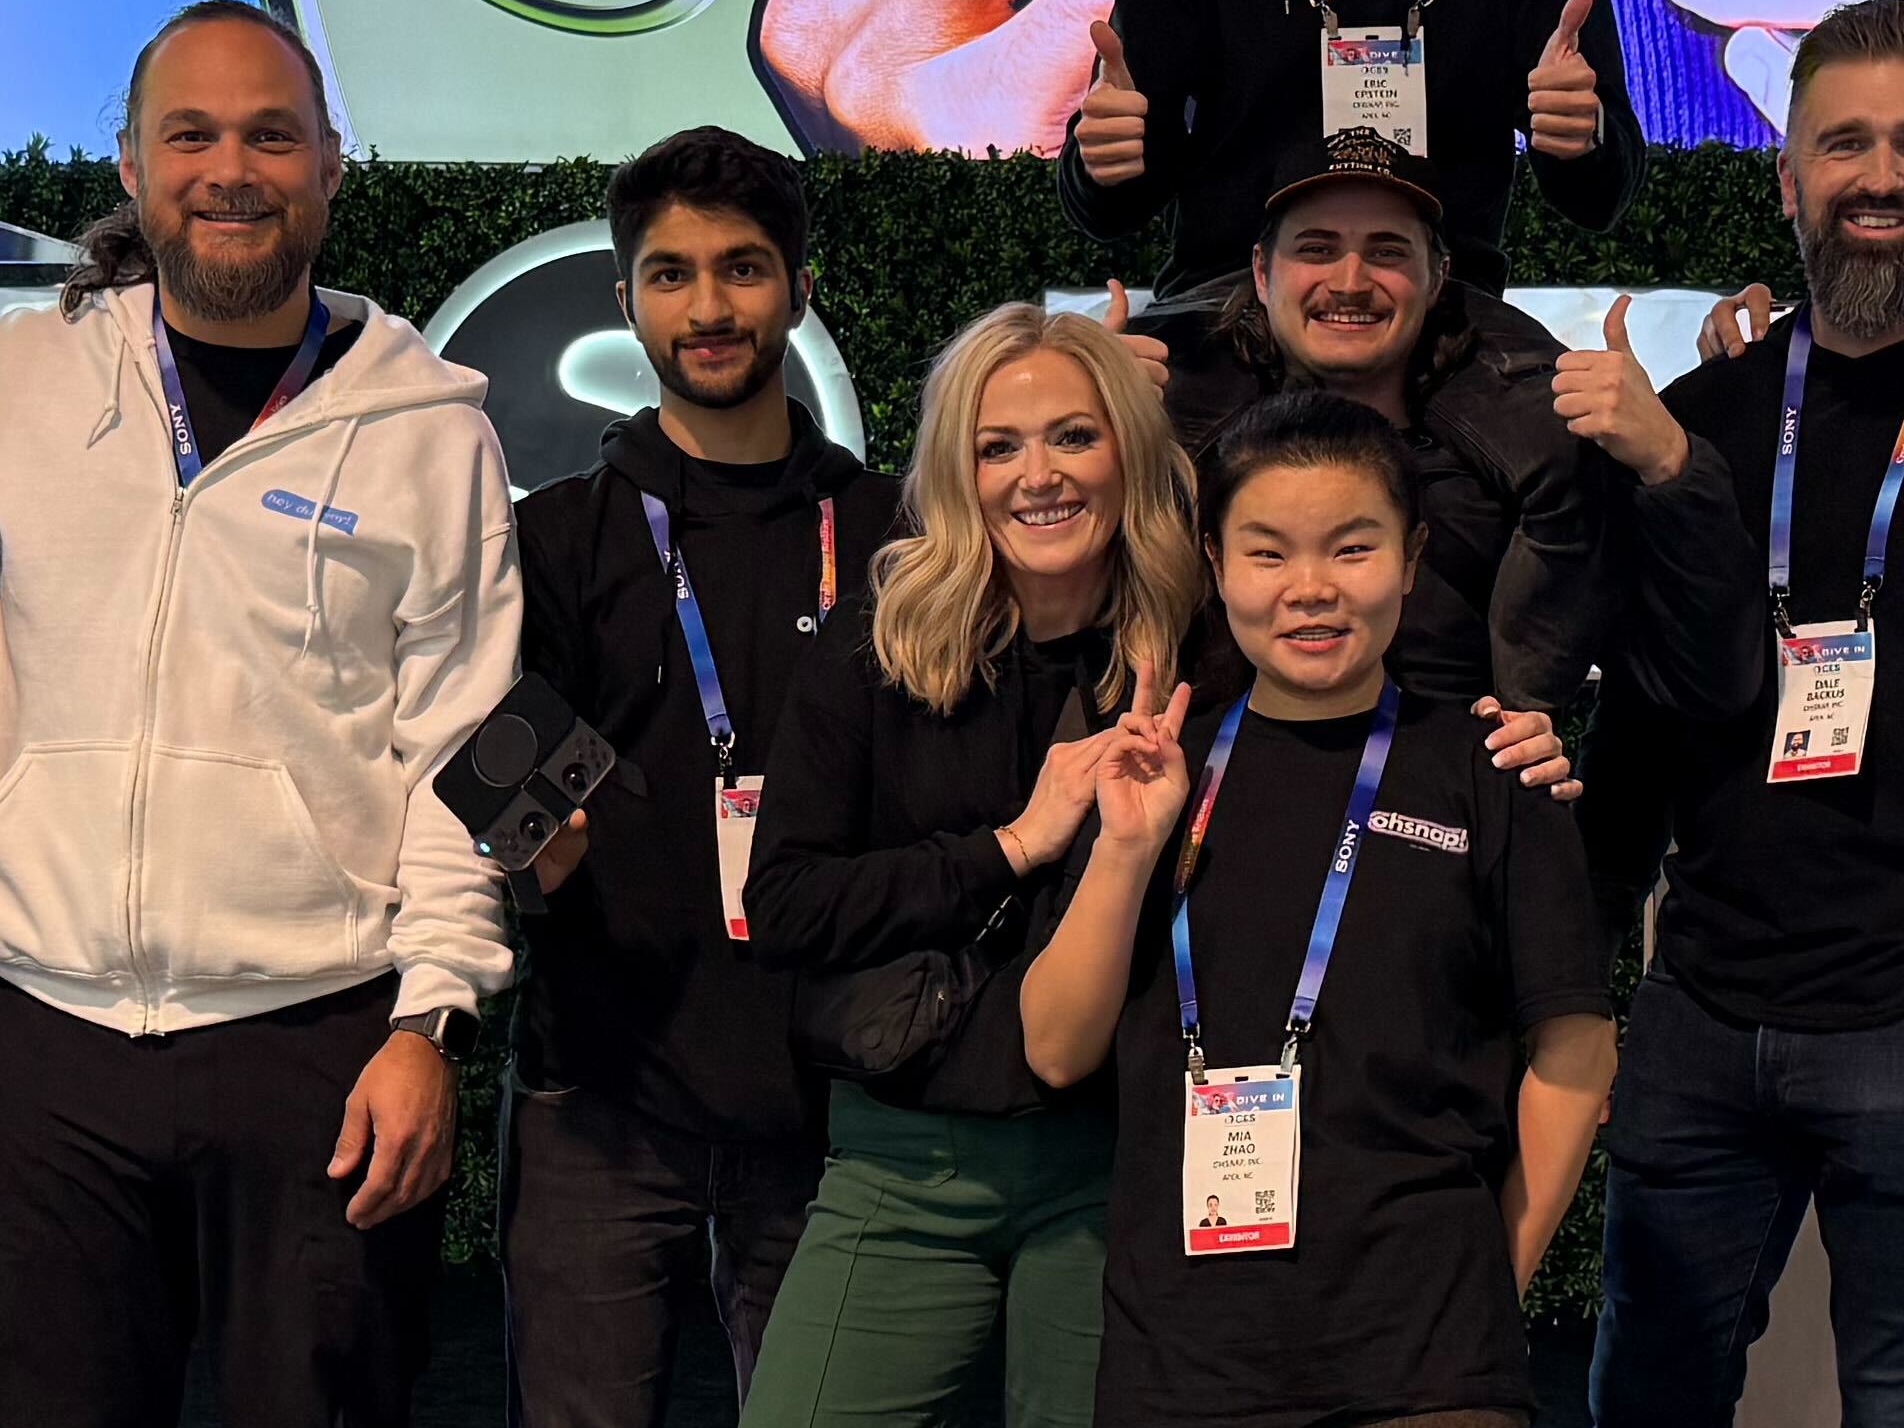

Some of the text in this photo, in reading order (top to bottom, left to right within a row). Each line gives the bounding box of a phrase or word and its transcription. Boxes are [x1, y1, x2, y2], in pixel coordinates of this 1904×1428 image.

[168, 403, 193, 456] SONY
[1781, 406, 1797, 456] SONY
[1854, 645, 1866, 654] IN
[1814, 678, 1841, 690] DALE
[1370, 811, 1468, 851] ohsnap!
[1335, 819, 1361, 874] SONY
[1236, 1092, 1285, 1106] DIVE IN
[1227, 1130, 1252, 1143] MIA
[1223, 1143, 1256, 1157] ZHAO
